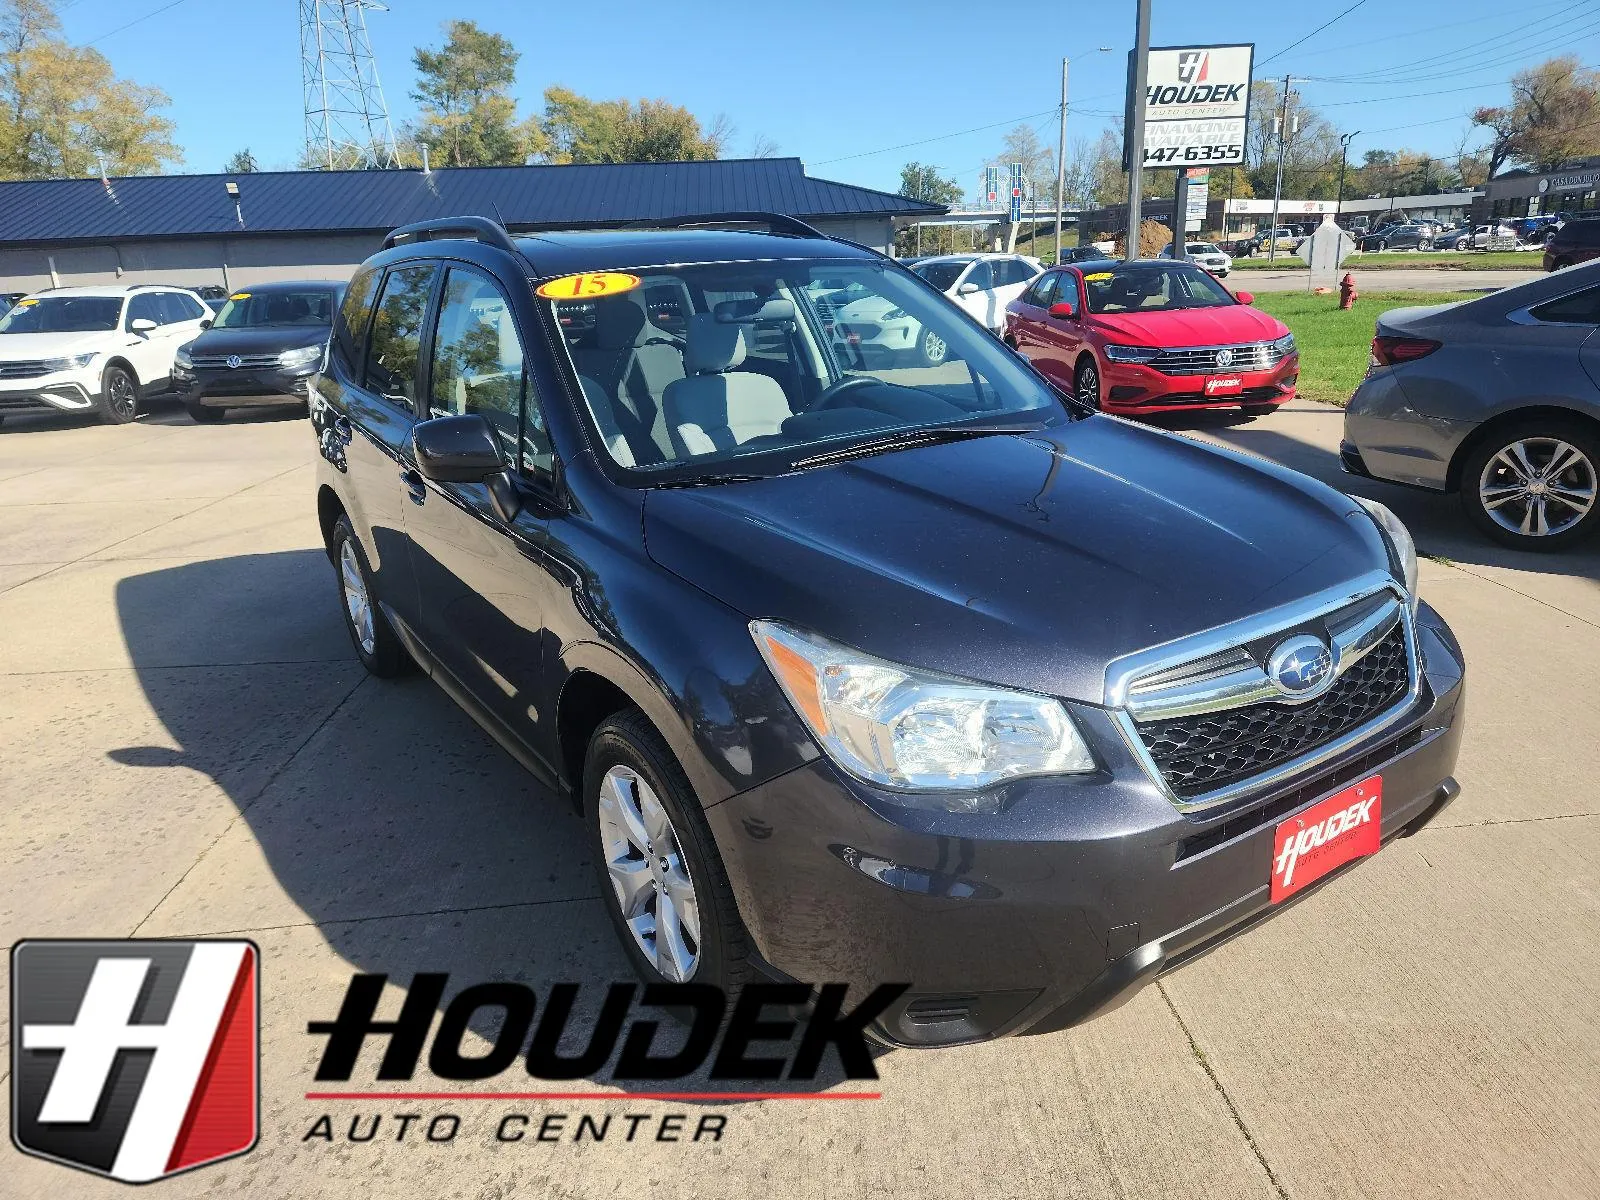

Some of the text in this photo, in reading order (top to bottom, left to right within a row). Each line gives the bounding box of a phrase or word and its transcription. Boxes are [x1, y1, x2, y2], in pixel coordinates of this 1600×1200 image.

[1146, 83, 1245, 106] HOUDEK
[1184, 106, 1229, 115] CENTER
[573, 275, 607, 296] 15
[1276, 796, 1377, 887] HOUDEK
